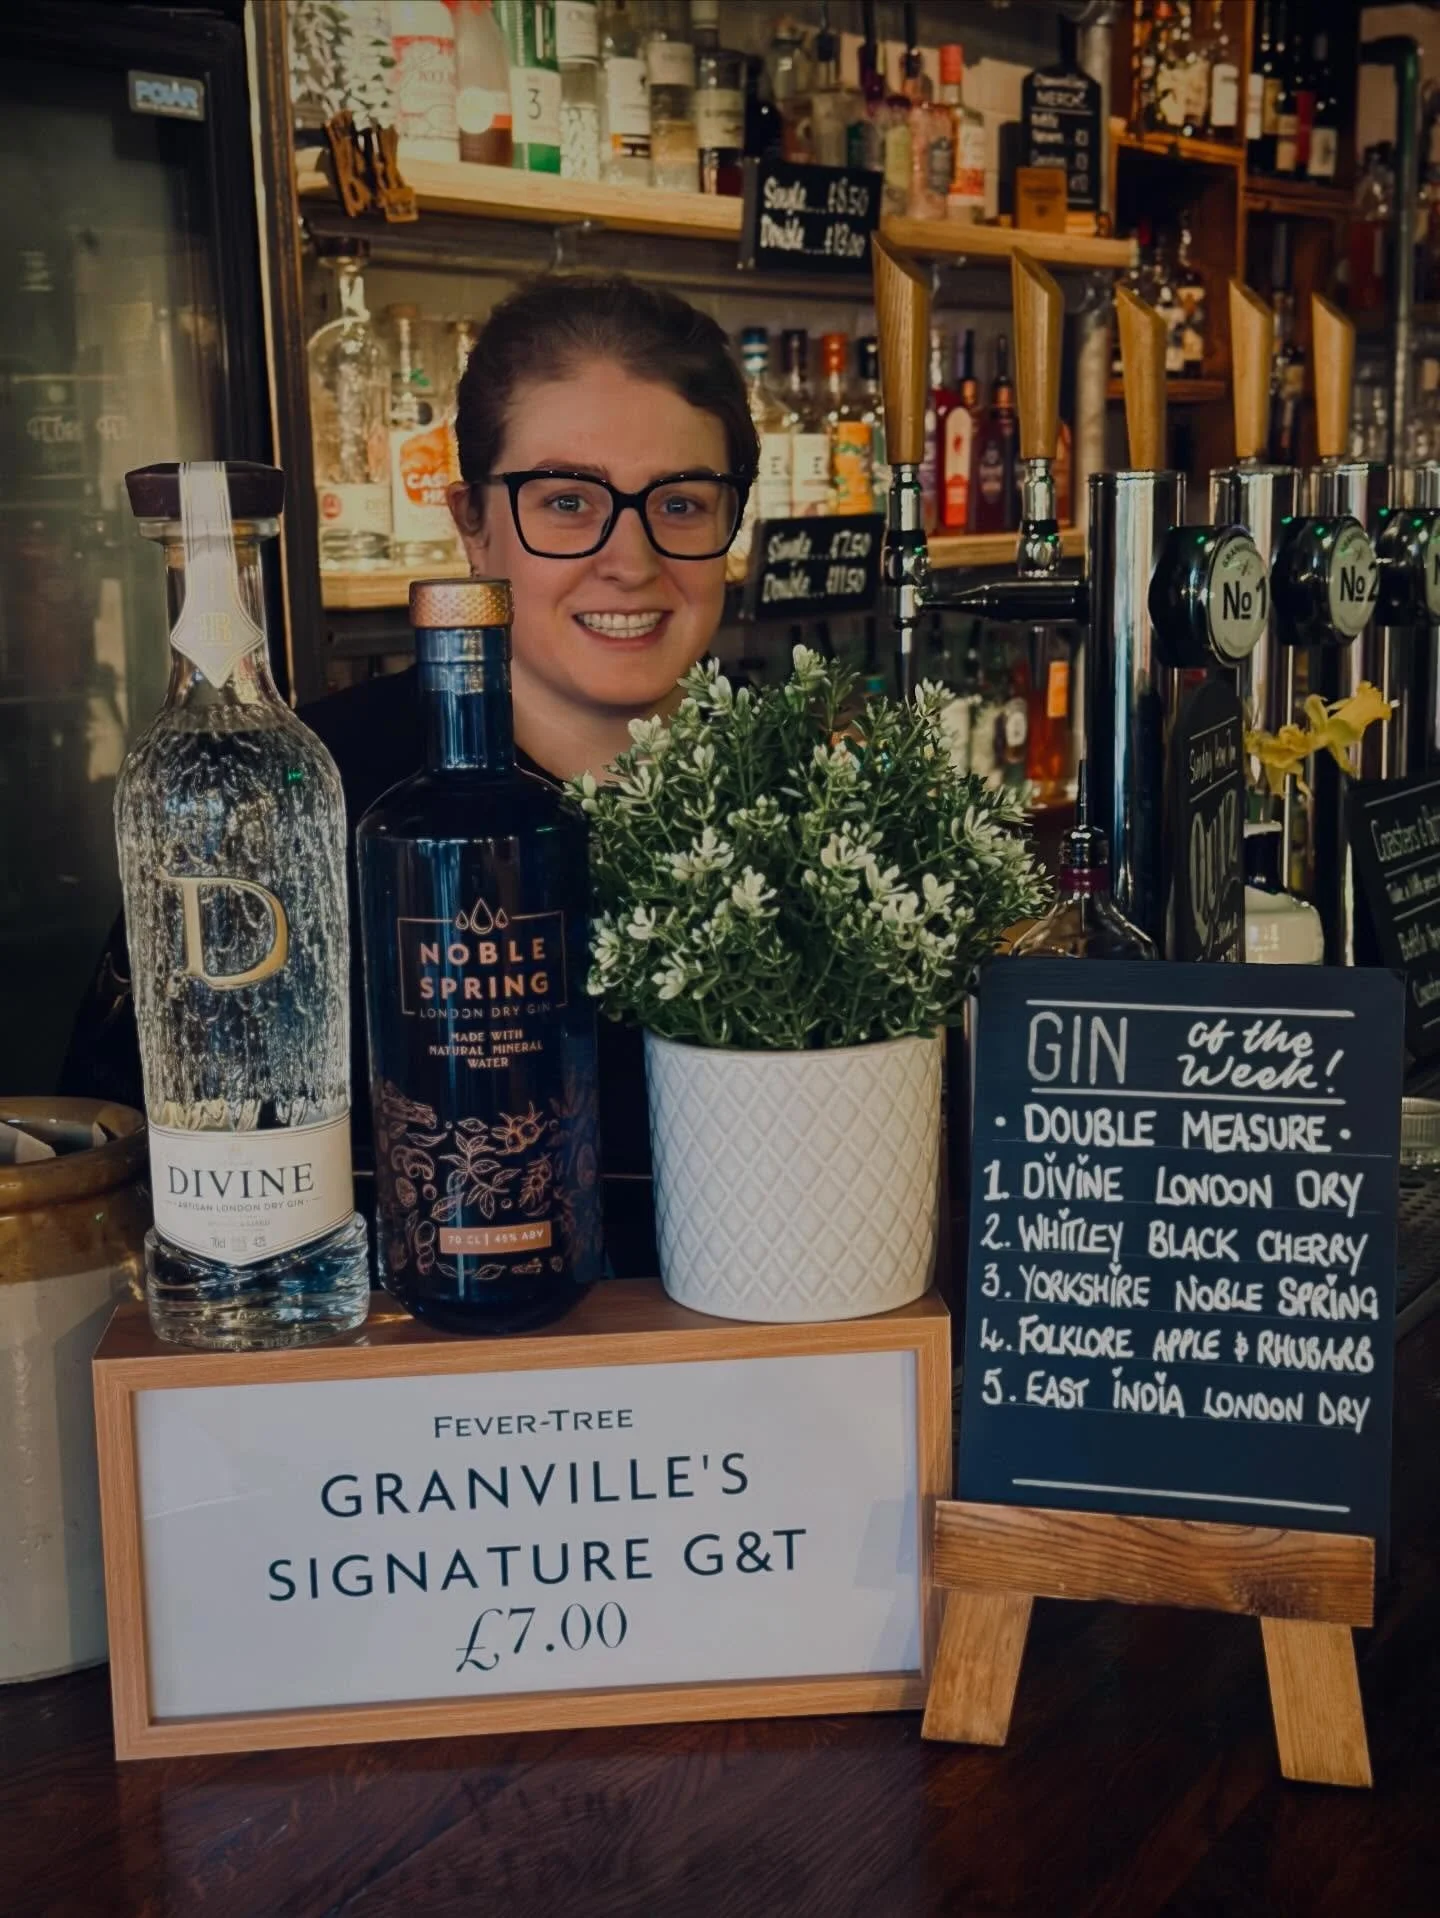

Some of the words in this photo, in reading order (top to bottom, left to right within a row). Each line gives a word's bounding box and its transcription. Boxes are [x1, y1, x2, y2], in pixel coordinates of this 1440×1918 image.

[528, 88, 541, 119] 3
[159, 871, 289, 993] D
[420, 937, 546, 966] NOBLE
[420, 971, 549, 1000] SPRING
[420, 1006, 484, 1019] LONDON
[491, 1004, 520, 1018] DRY
[526, 1001, 552, 1014] GIN
[429, 1045, 485, 1056] NATURAL
[492, 1040, 543, 1054] MINERAL
[451, 1031, 485, 1043] MADE
[491, 1028, 523, 1040] WITH
[1027, 1011, 1128, 1086] GIN
[1188, 1019, 1235, 1055] of
[1242, 1019, 1315, 1058] the
[467, 1057, 509, 1069] WATER
[1023, 1103, 1157, 1148] DOUBLE
[1181, 1109, 1333, 1154] MEASURE
[168, 1162, 314, 1199] DIVINE
[1155, 1165, 1273, 1209] LONDON
[1296, 1169, 1364, 1218] DRY
[216, 1204, 261, 1213] LONDON
[263, 1202, 284, 1211] DRY
[286, 1199, 304, 1208] GIN
[521, 1229, 544, 1240] ABV
[980, 1213, 1011, 1250] 2.
[1148, 1219, 1240, 1262] BLACK
[1257, 1229, 1369, 1277] CHERRY
[980, 1263, 1012, 1298] 3.
[1175, 1274, 1264, 1313] NOBLE
[980, 1317, 1012, 1353] 4.
[1018, 1313, 1135, 1359] FOLKLORE
[1152, 1328, 1222, 1363] APPLE
[1234, 1331, 1249, 1364] &
[1257, 1329, 1376, 1375] RHUBARB
[982, 1367, 1017, 1406] 5.
[1025, 1370, 1090, 1411] EAST
[1203, 1386, 1303, 1423] LONDON
[1318, 1392, 1371, 1434] DRY
[320, 1451, 750, 1519] GRANVILLE'S
[267, 1537, 654, 1603] SIGNATURE
[683, 1528, 809, 1577] G&T
[454, 1600, 628, 1674] £7.00
